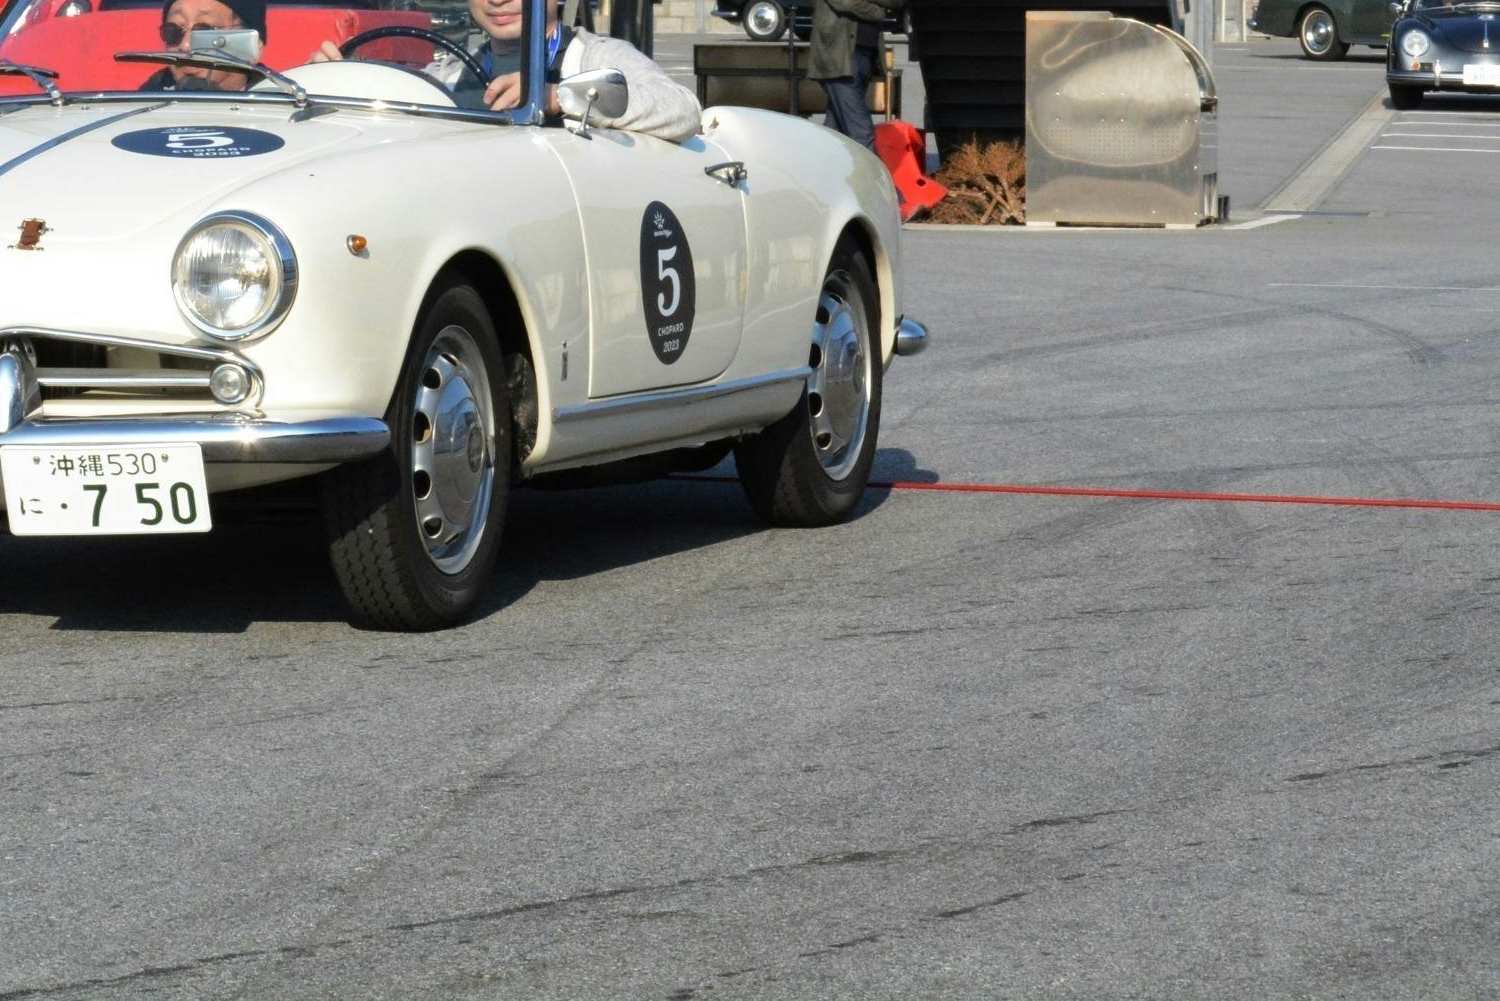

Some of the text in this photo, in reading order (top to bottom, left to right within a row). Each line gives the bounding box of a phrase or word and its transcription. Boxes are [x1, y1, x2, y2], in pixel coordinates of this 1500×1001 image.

[165, 131, 234, 148] 5
[657, 246, 681, 317] 5
[657, 322, 684, 337] CHOPARD
[49, 453, 156, 476] 沖縄530
